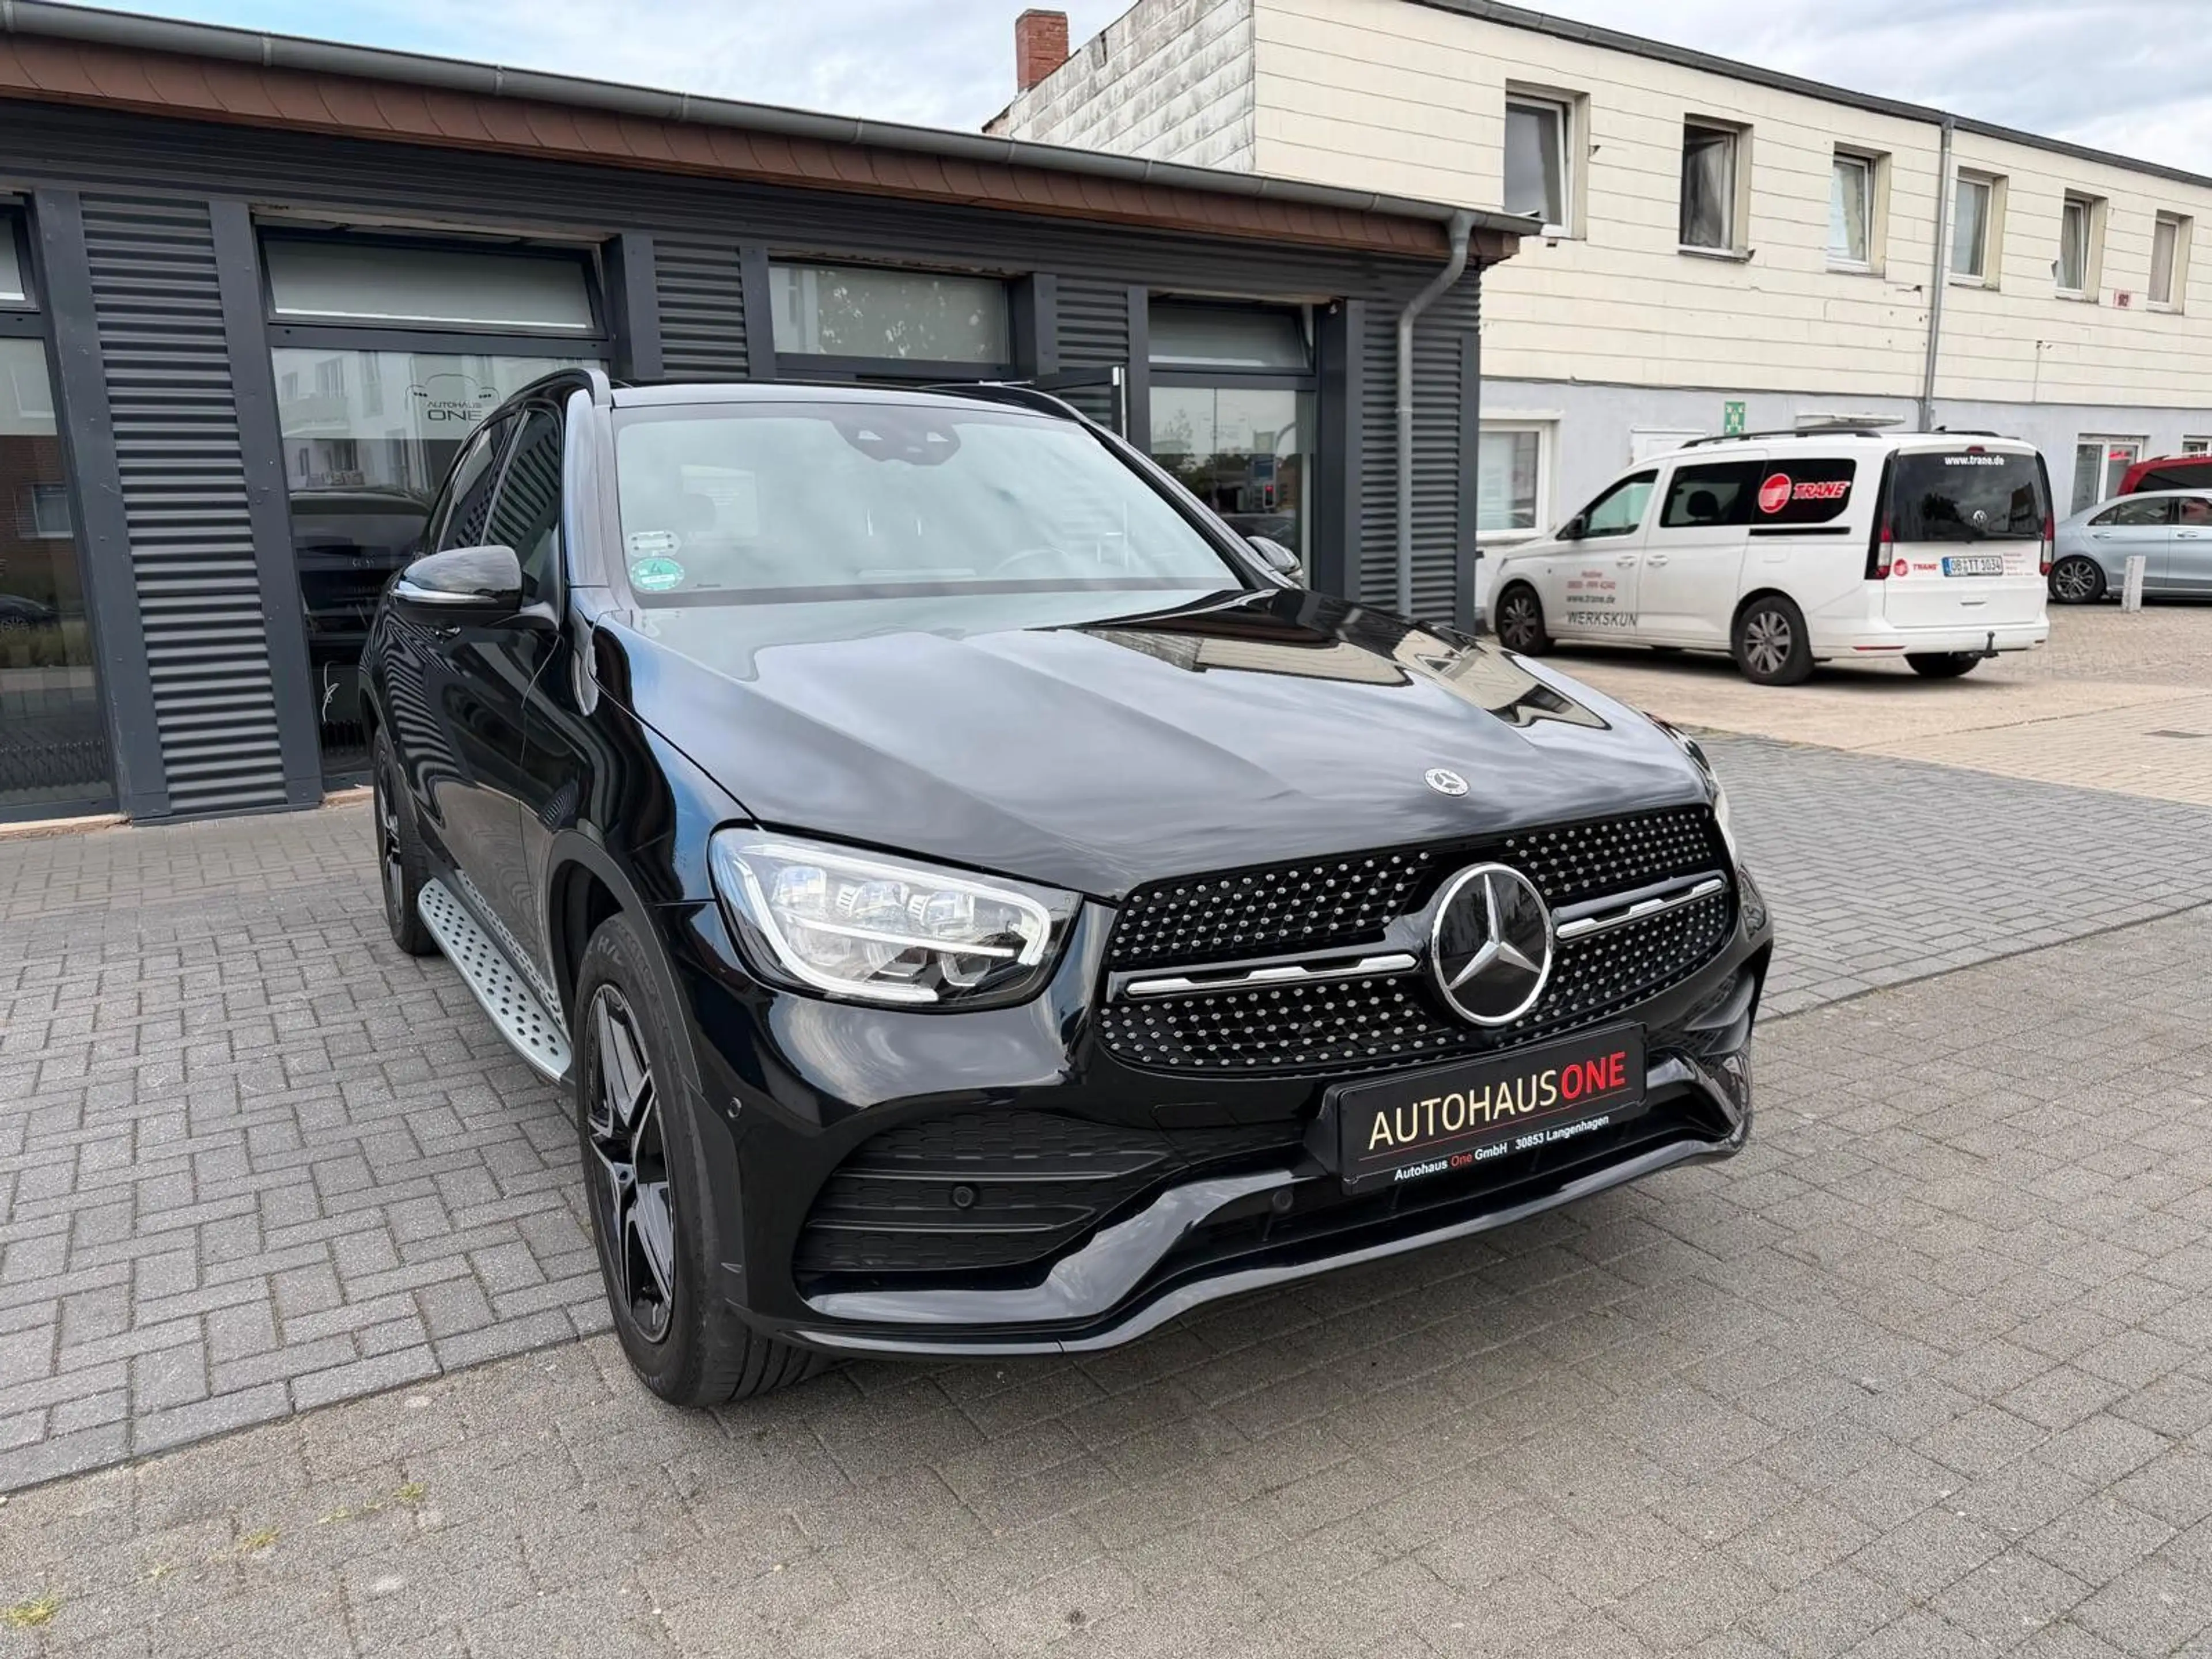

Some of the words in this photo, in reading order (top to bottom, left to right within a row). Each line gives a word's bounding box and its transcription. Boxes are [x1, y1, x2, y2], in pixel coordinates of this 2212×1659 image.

[428, 410, 482, 421] ONE
[1945, 454, 2005, 465] www.trane.de
[1792, 480, 1851, 499] TRANE
[1567, 611, 1637, 627] WERKSKUN
[1394, 1160, 1448, 1181] Autohaus
[1450, 1154, 1473, 1166] One
[1475, 1142, 1508, 1161] GmbH
[1515, 1132, 1544, 1150] 30853
[1546, 1115, 1609, 1142] Langenhagen
